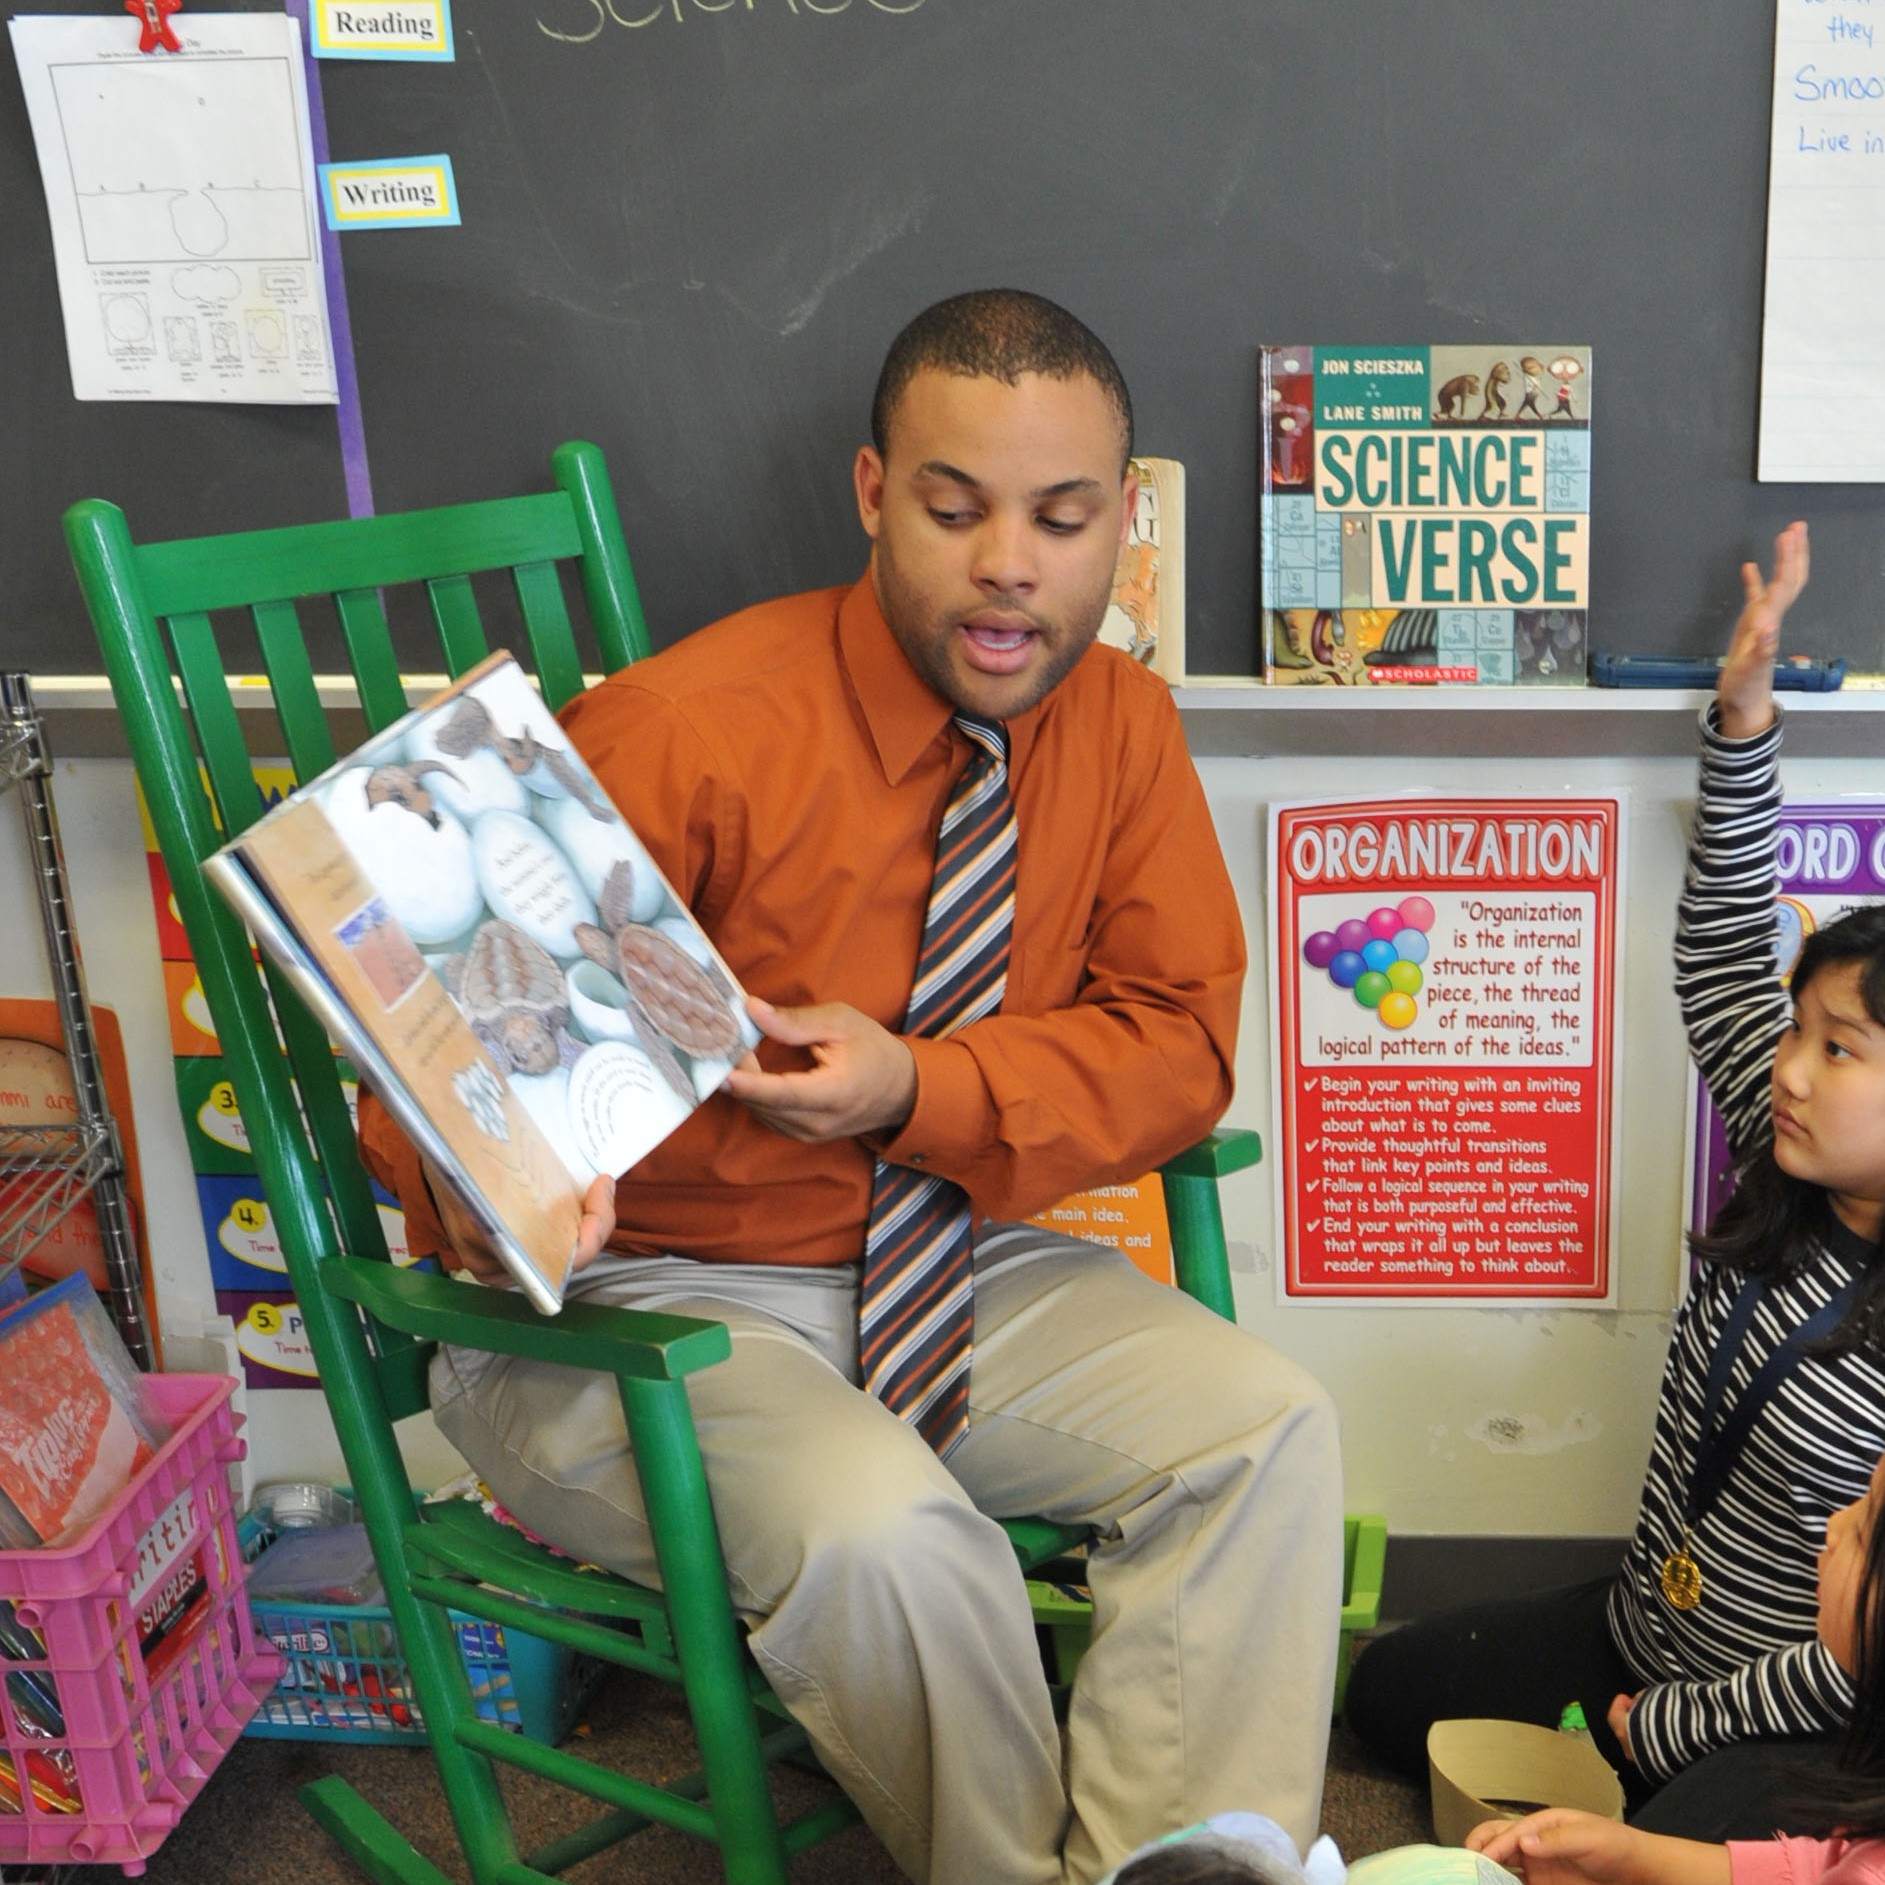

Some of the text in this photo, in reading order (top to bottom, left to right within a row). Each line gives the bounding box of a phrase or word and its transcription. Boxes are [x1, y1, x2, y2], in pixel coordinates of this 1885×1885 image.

[336, 11, 434, 39] Reading
[1826, 15, 1873, 49] they
[1794, 64, 1885, 101] Smoo
[1799, 126, 1851, 152] Live
[344, 182, 435, 211] Writing
[1321, 360, 1424, 375] JON SCIESZKA
[1324, 406, 1422, 420] LANE SMITH
[1321, 434, 1538, 508] SCIENCE
[1377, 519, 1577, 603] VERSE
[1384, 669, 1477, 681] SCHOLASTIC
[1291, 822, 1600, 880] ORGANIZATION
[1461, 902, 1582, 926] "Organization
[1453, 929, 1582, 949] is the internal
[1433, 957, 1581, 976] structure of the
[1427, 983, 1581, 1008] piece, the thread
[1439, 1010, 1580, 1035] of meaning, the
[1319, 1036, 1580, 1060] logical pattern of the ideas."
[1321, 1077, 1580, 1095] Begin your writing with an inviting
[1321, 1098, 1581, 1115] introduction that gives some clues
[1321, 1118, 1496, 1133] about what is to come.
[1322, 1138, 1546, 1156] Provide thoughtful transitions
[1323, 1158, 1552, 1176] that link key points and ideas.
[1323, 1179, 1589, 1196] Follow a logical sequence in your writing
[1052, 1206, 1086, 1221] main
[1093, 1206, 1128, 1223] idea.
[1323, 1199, 1577, 1217] that is both purposeful and effective.
[1323, 1218, 1578, 1236] End your writing with a conclusion
[248, 1240, 275, 1253] Time
[1125, 1232, 1151, 1247] and
[1323, 1239, 1583, 1256] that wraps it all up but leaves the
[1324, 1259, 1373, 1273] reader
[1380, 1259, 1453, 1277] something
[1460, 1259, 1474, 1273] to
[1481, 1259, 1518, 1273] think
[274, 1342, 301, 1354] Time
[141, 1556, 198, 1634] STAPLES
